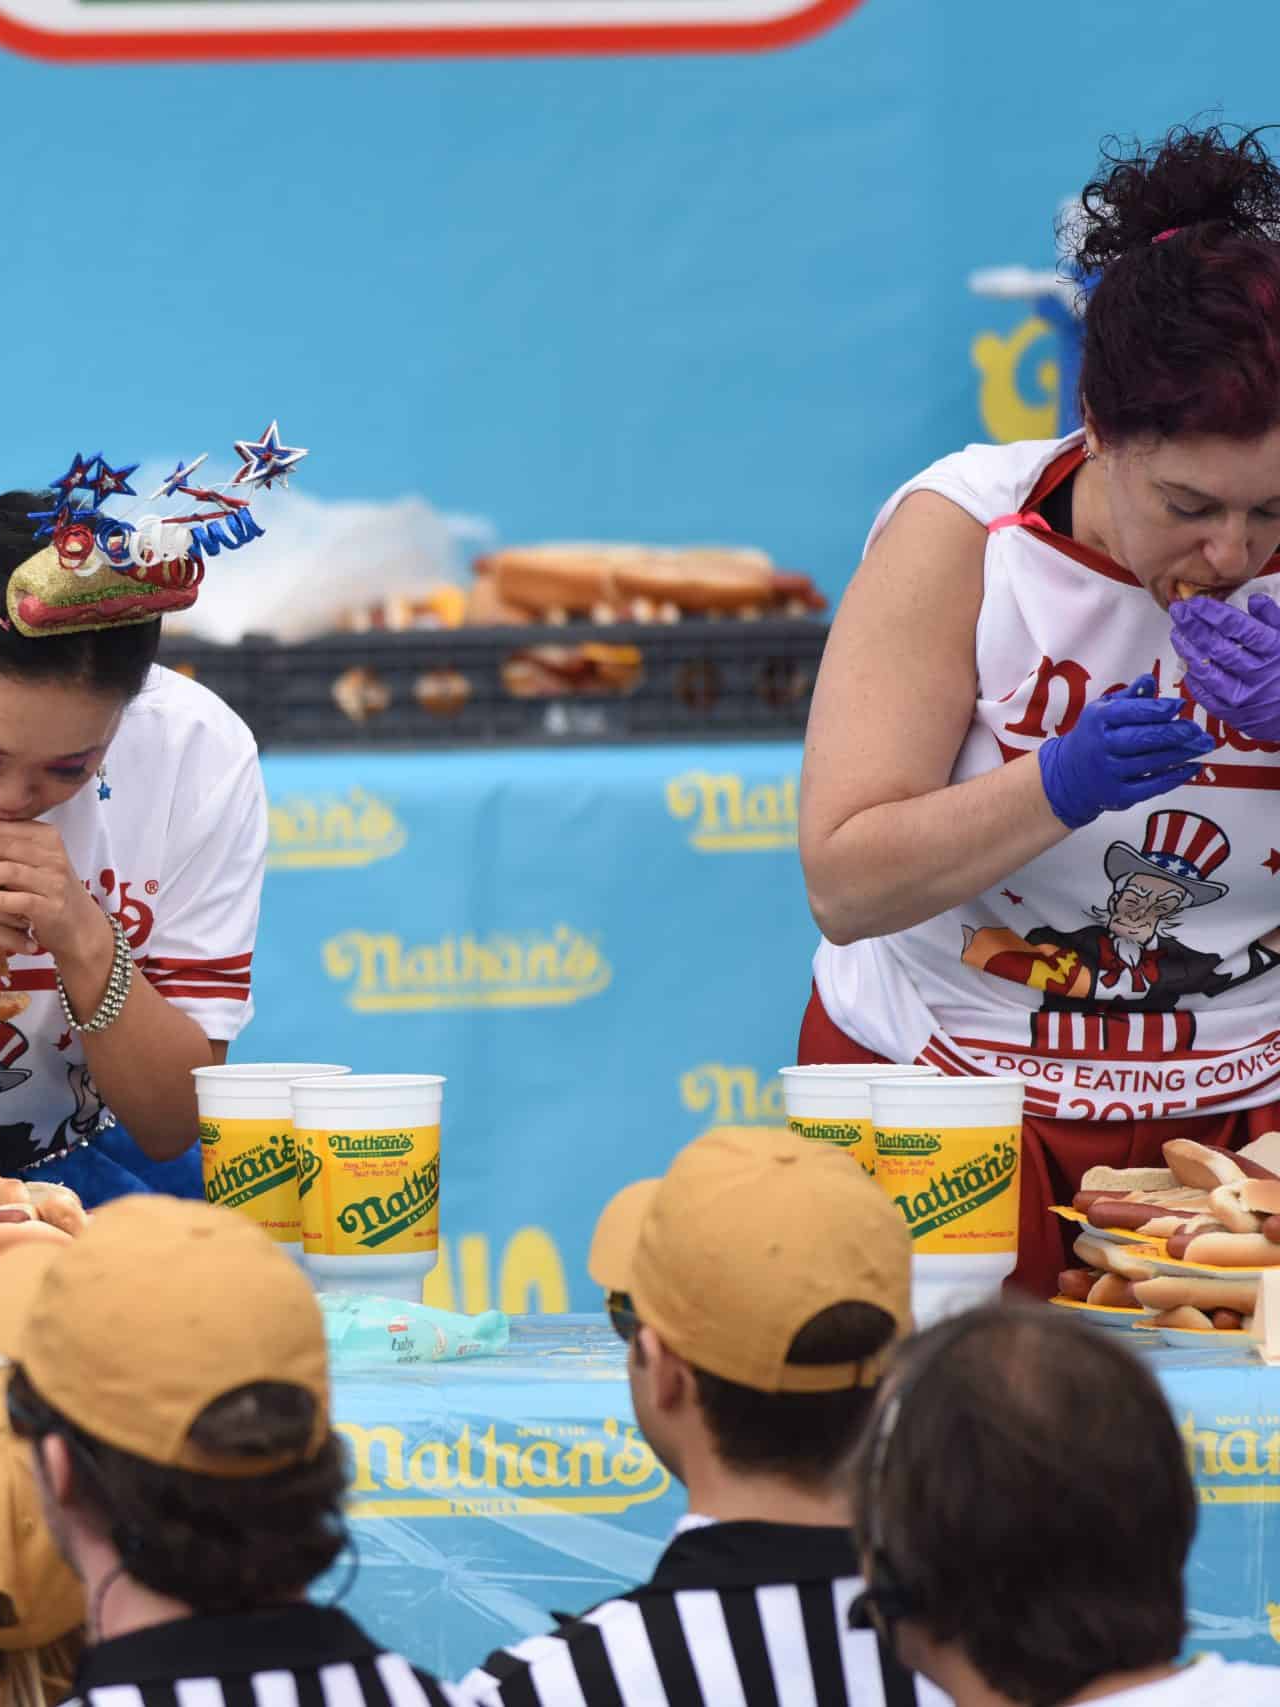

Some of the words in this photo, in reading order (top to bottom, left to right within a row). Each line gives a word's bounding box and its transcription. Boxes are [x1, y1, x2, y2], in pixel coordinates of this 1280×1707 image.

[324, 924, 610, 998] Nathan's
[1074, 1066, 1185, 1093] EATING
[206, 1134, 297, 1204] athan's
[328, 1133, 414, 1153] Nathan's
[331, 1416, 671, 1493] Nathan's
